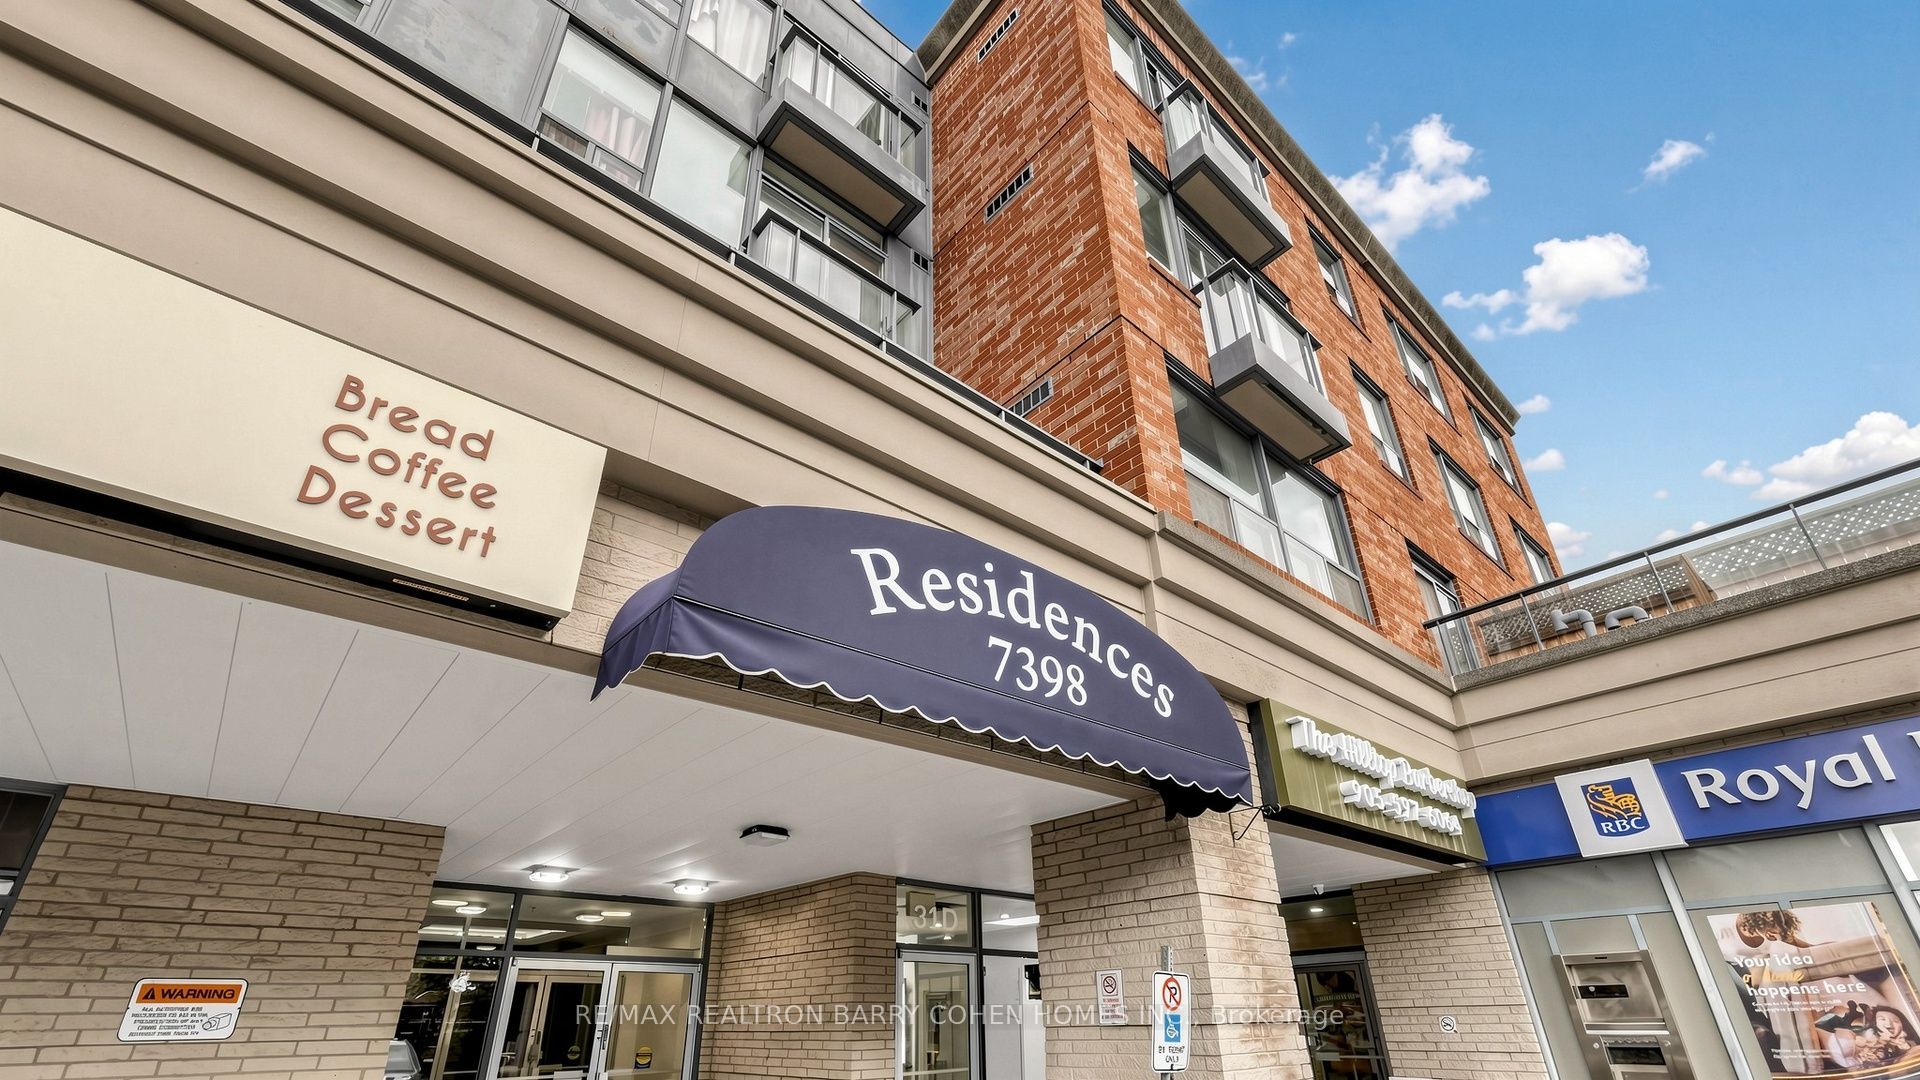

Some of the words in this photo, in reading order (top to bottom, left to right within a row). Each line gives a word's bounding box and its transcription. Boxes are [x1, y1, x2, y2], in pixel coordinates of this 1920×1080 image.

[334, 374, 495, 462] Bread
[321, 423, 498, 510] Coffee
[296, 464, 497, 559] Dessert
[850, 547, 1175, 719] Residences
[987, 634, 1089, 707] 7398
[1680, 733, 1897, 810] Royal
[1600, 816, 1646, 834] RBC
[913, 904, 959, 932] 31D
[160, 988, 236, 1000] WARNING
[1735, 955, 1770, 968] Your
[1773, 953, 1814, 967] idea
[1745, 983, 1820, 1001] happens
[1823, 980, 1867, 994] here
